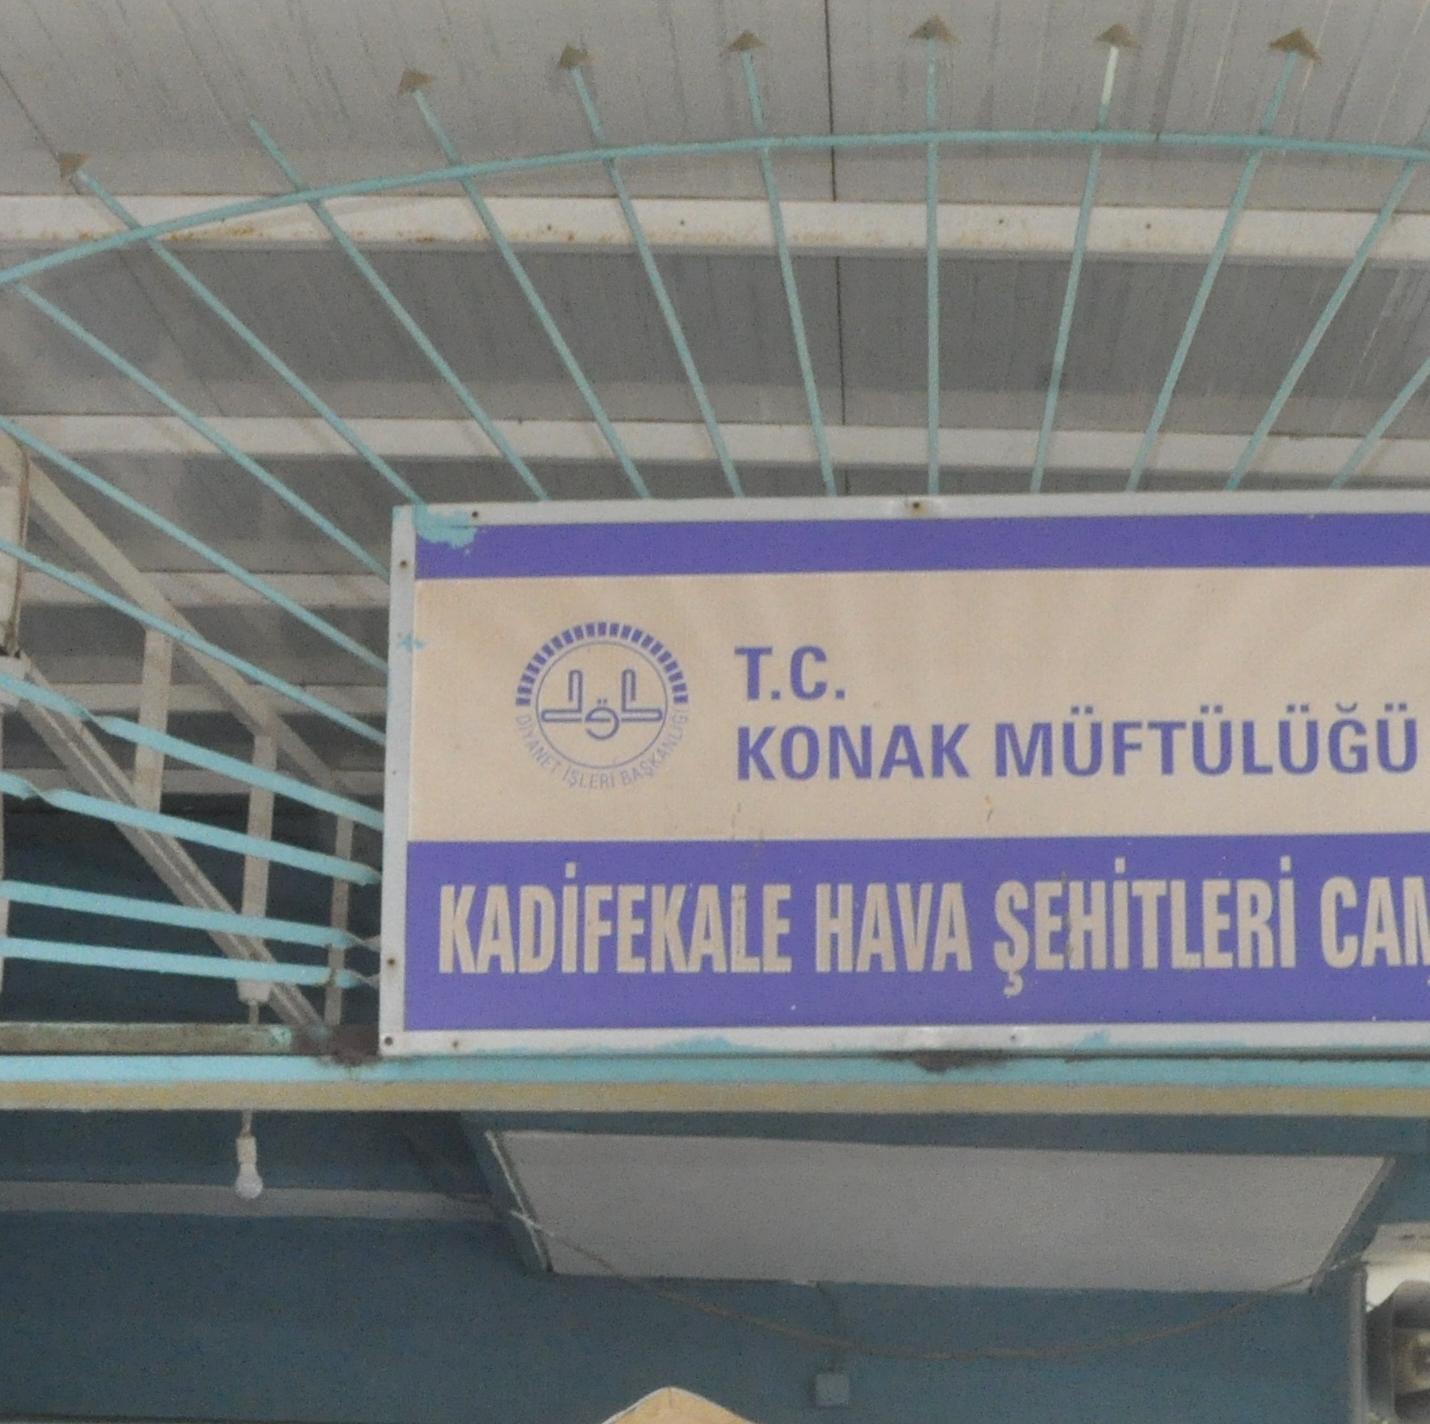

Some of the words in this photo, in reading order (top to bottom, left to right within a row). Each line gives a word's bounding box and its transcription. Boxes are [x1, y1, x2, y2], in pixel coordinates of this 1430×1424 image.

[734, 645, 846, 700] T.C.
[736, 722, 971, 781] KONAK
[994, 701, 1419, 778] MÜFTÜLÜĞÜ
[438, 861, 793, 974] KADİFEKALE
[815, 881, 974, 973] HAVA
[993, 855, 1297, 998] ŞEHİTLERİ
